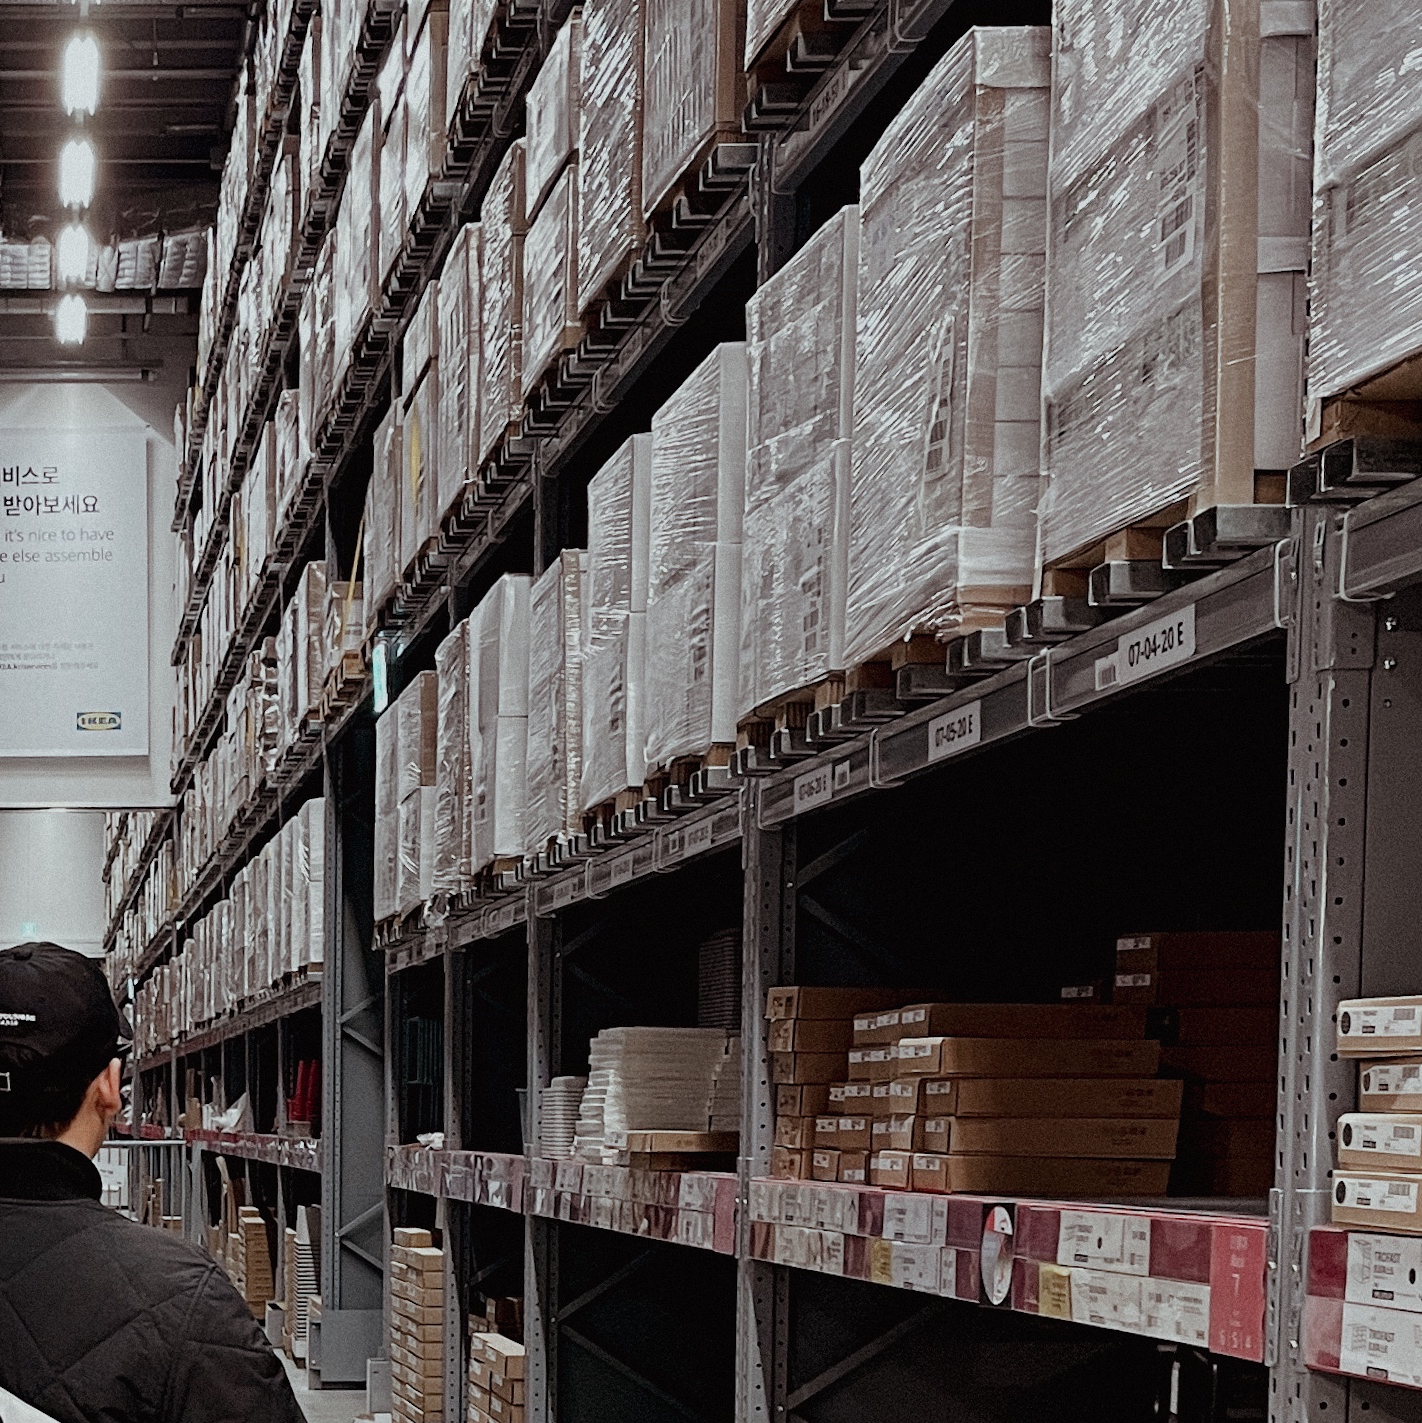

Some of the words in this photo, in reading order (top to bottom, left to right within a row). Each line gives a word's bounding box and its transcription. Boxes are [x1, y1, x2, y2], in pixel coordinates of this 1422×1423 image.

[3, 494, 100, 516] 받아보세요
[5, 528, 24, 543] it's
[28, 529, 57, 542] nice
[61, 530, 76, 542] to
[80, 527, 115, 542] have
[12, 549, 40, 563] else
[45, 548, 113, 563] assemble
[1128, 626, 1174, 667] 07-04-20
[1178, 621, 1184, 646] E
[1232, 1273, 1240, 1297] 7
